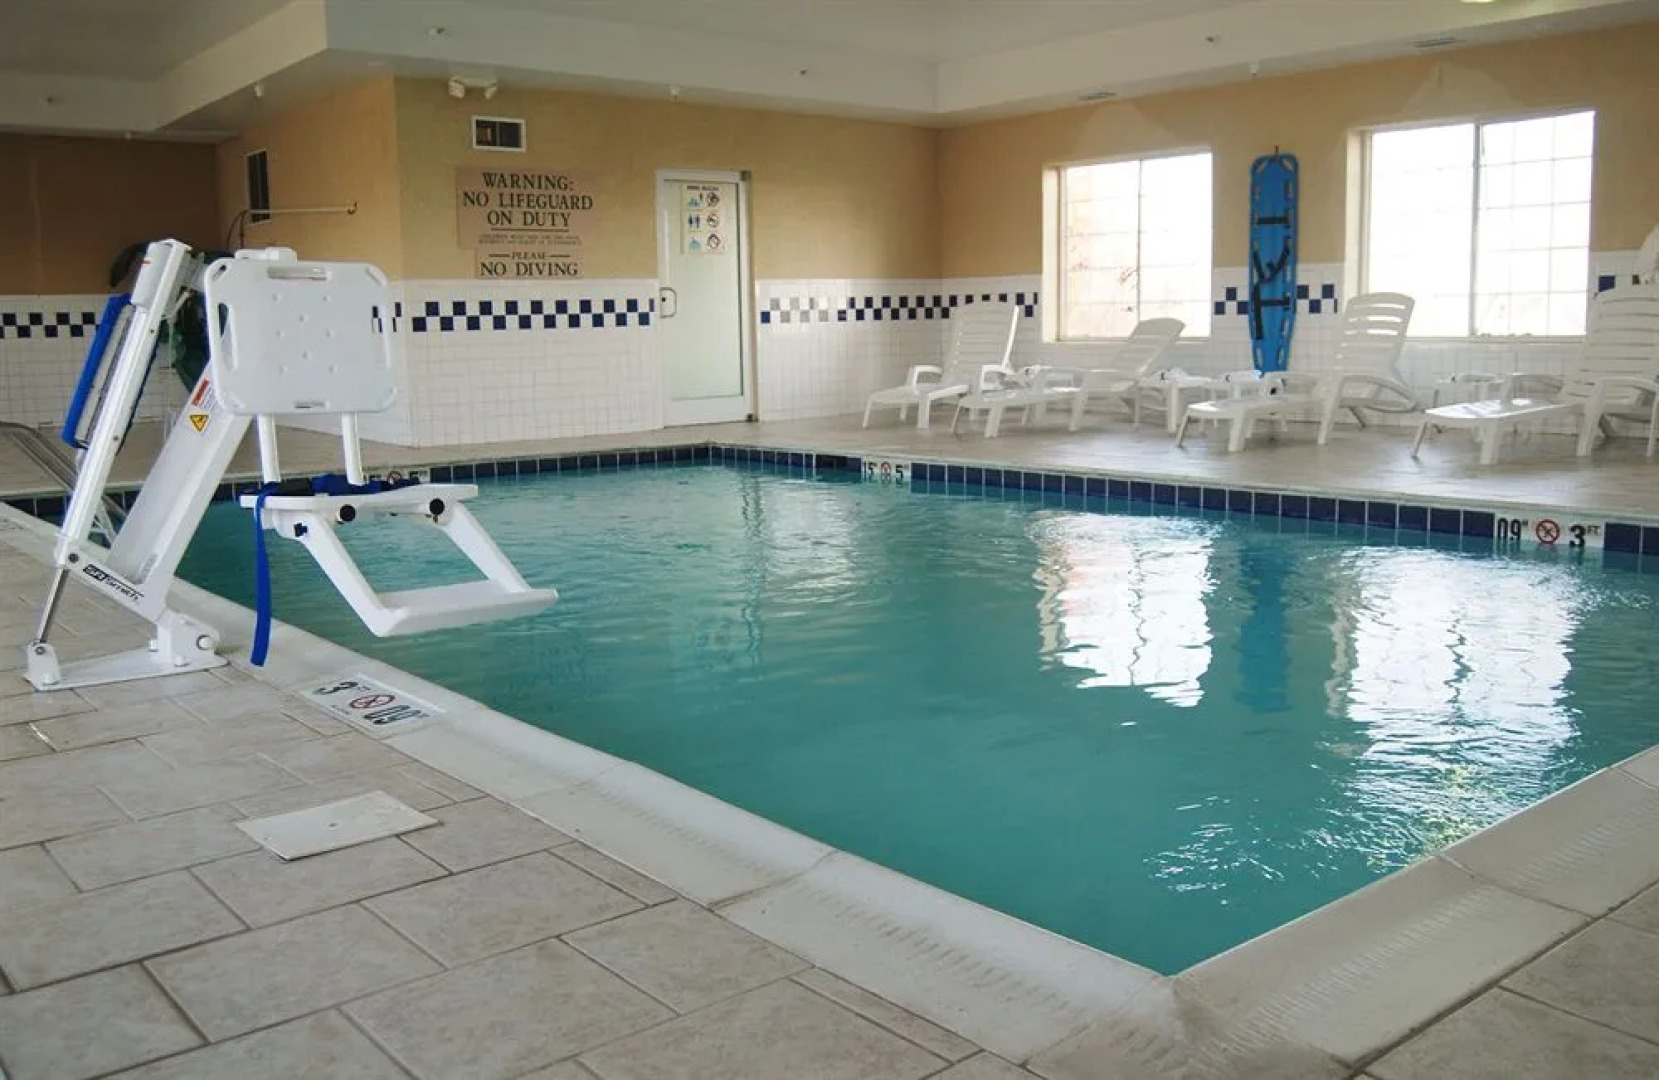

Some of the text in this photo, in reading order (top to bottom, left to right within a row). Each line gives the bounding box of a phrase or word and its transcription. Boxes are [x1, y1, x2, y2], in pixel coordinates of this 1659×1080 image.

[482, 172, 574, 191] WARNING:
[463, 191, 593, 210] NO LIFEGUARD
[487, 210, 571, 227] ON DUTY
[481, 262, 578, 276] NO DIVING
